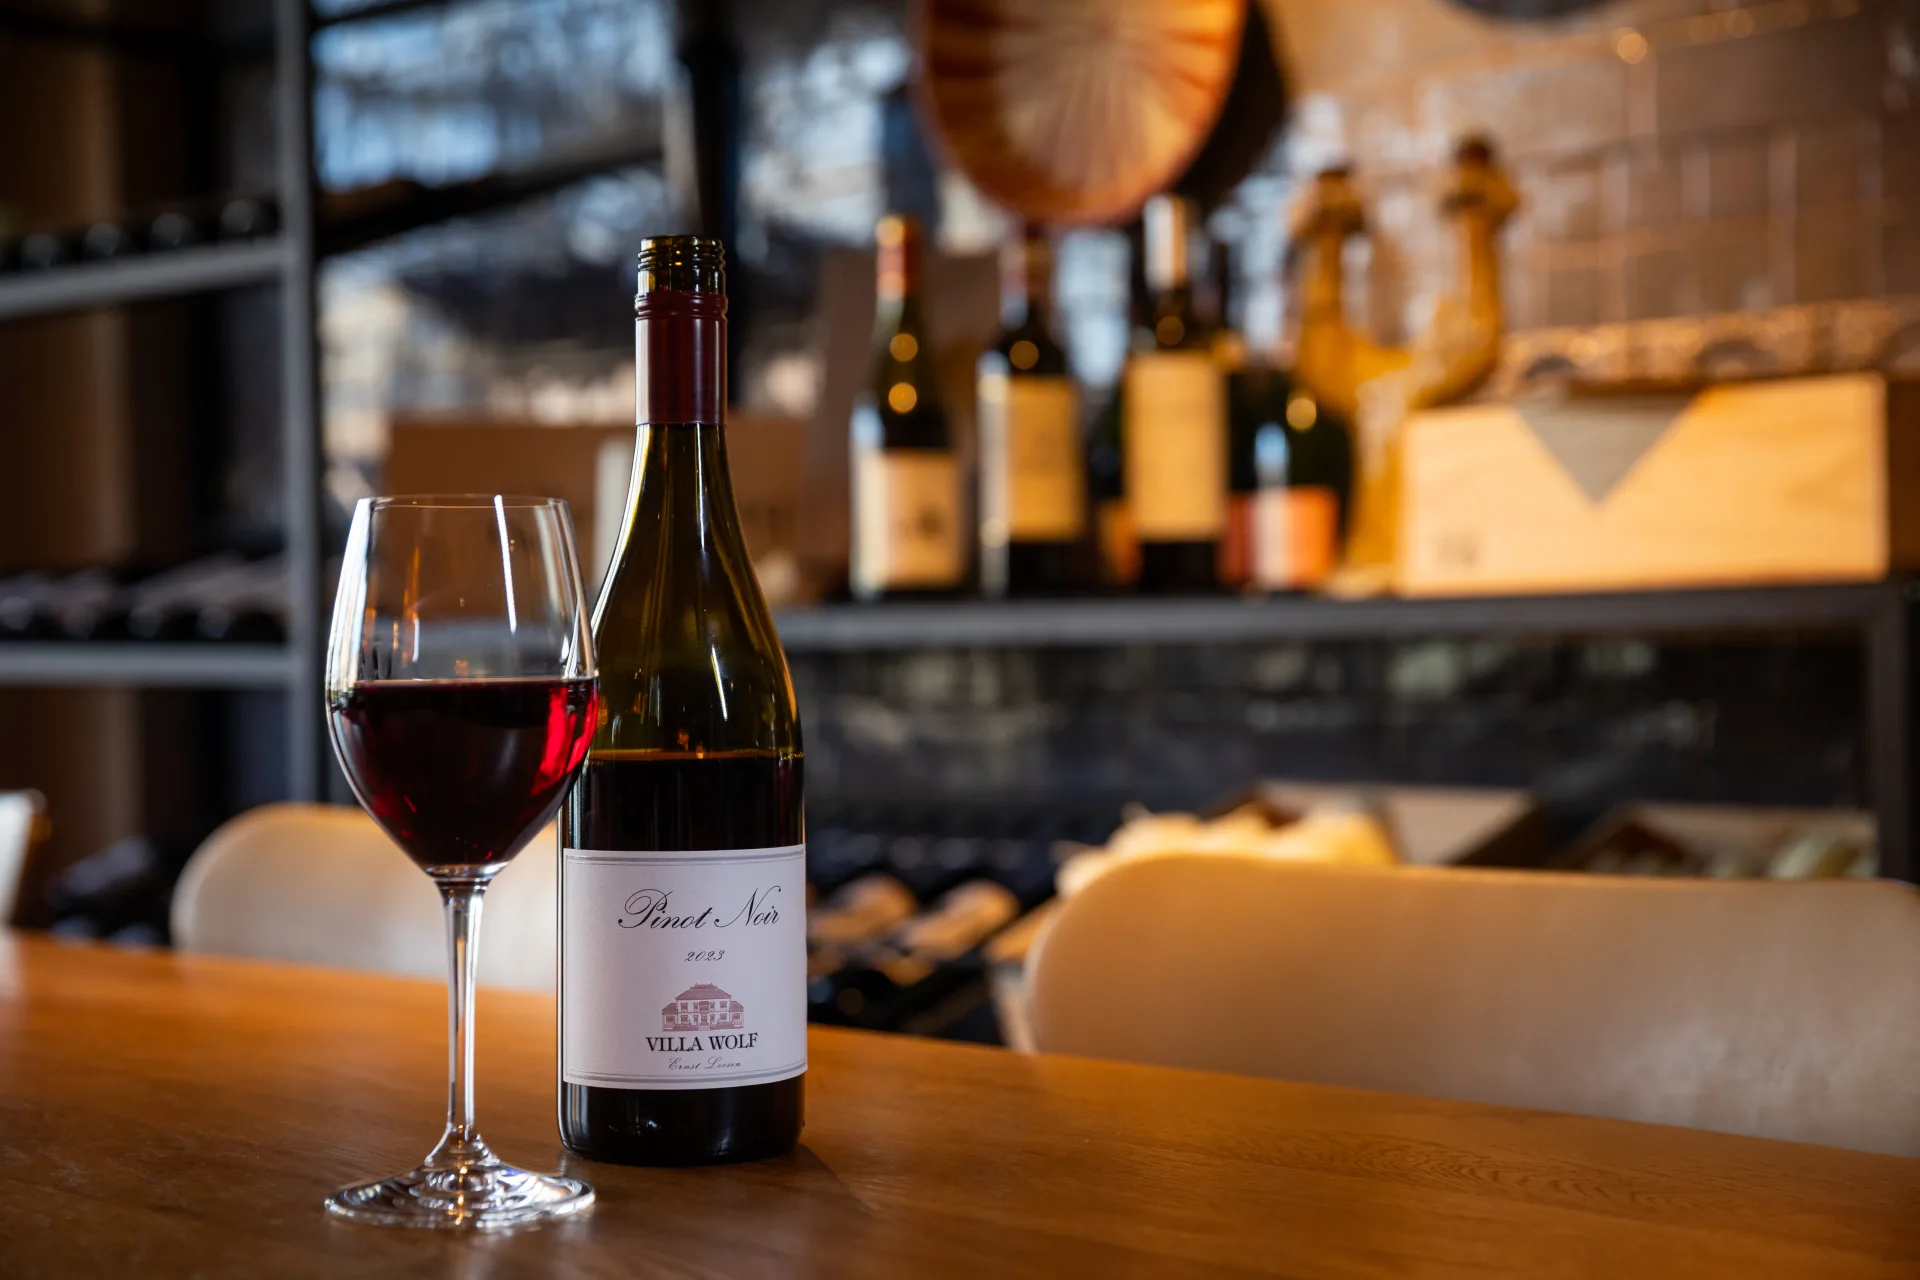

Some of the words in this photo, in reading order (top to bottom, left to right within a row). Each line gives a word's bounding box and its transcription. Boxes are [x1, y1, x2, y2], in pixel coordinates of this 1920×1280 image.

[617, 888, 713, 929] Pinot
[714, 885, 782, 927] Noir
[684, 949, 726, 962] 2023
[645, 1036, 704, 1052] VILLA
[708, 1032, 759, 1050] WOLF
[668, 1057, 701, 1071] Ernst
